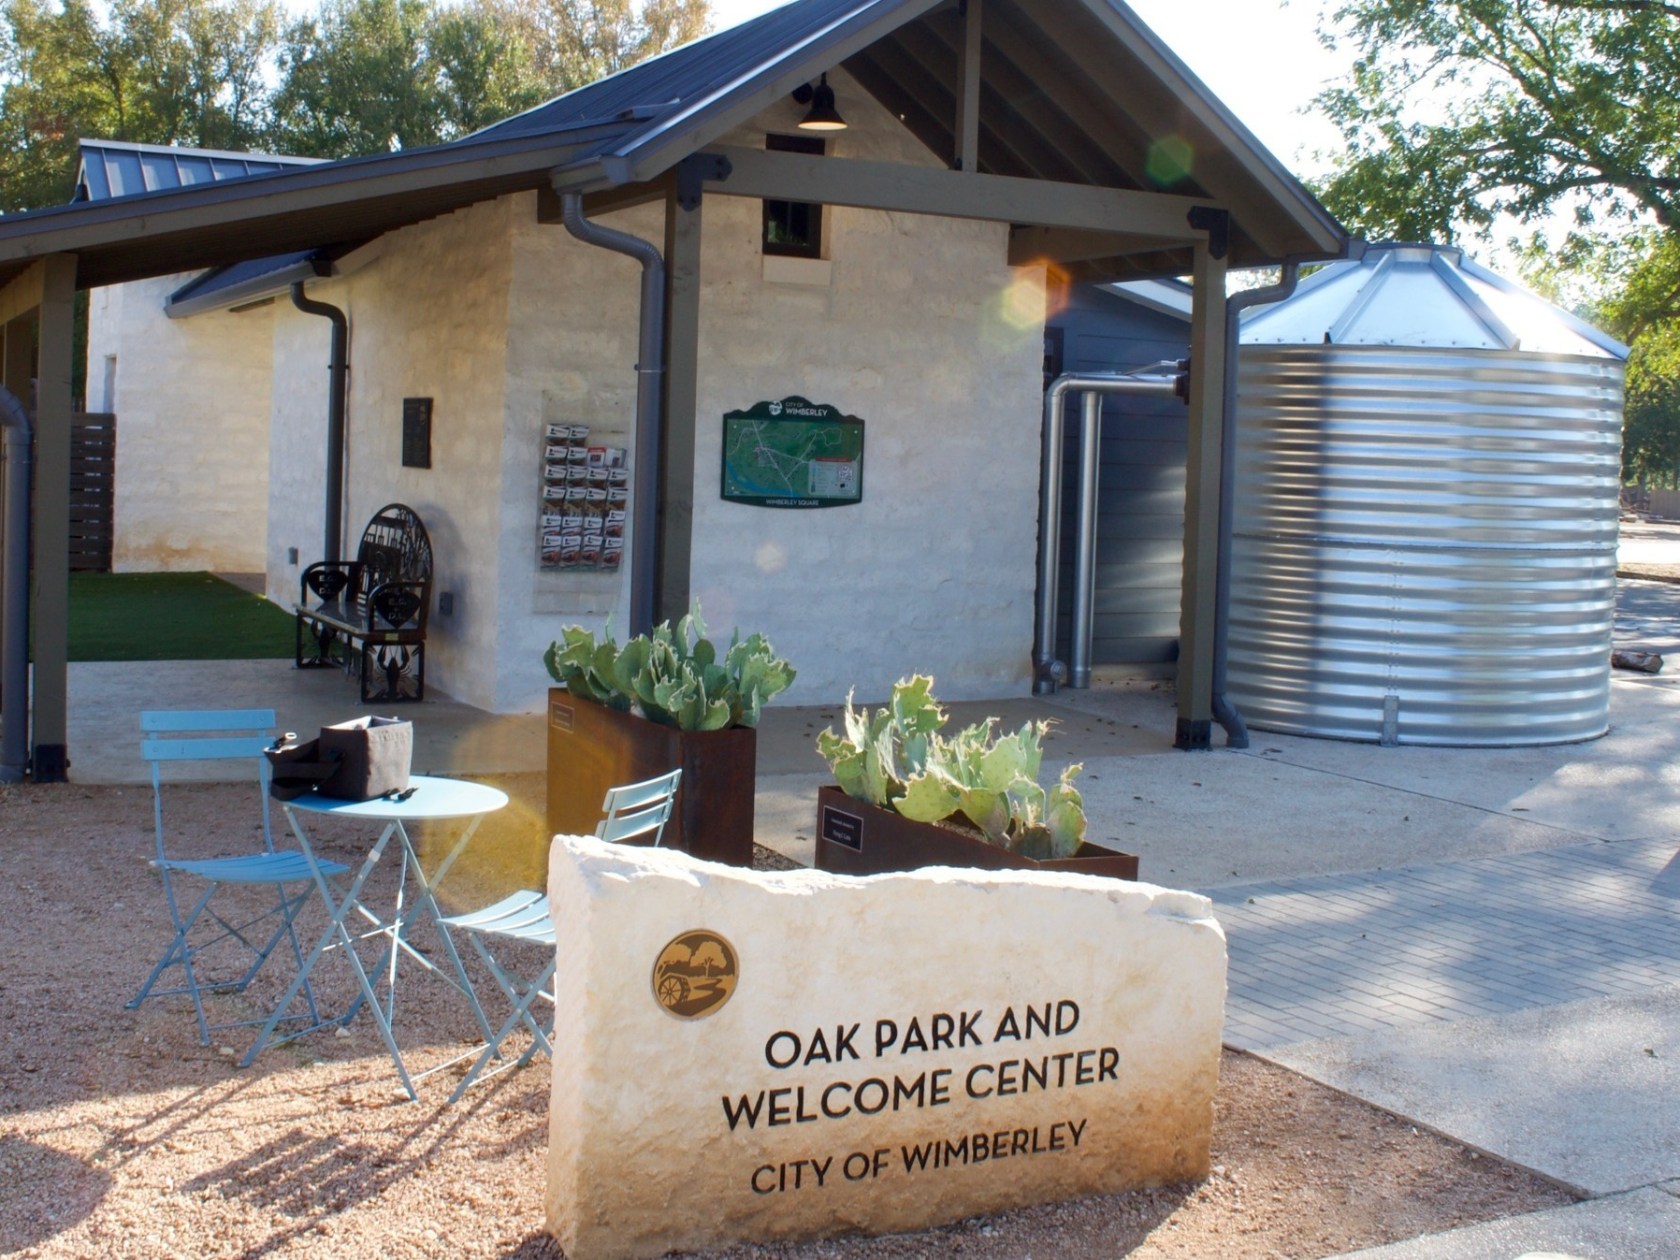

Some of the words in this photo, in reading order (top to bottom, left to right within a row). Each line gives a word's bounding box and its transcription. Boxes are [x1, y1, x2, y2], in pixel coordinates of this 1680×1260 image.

[786, 408, 828, 417] WIMBERLEY
[765, 1024, 860, 1068] OAK
[876, 1011, 982, 1057] PARK
[994, 1000, 1079, 1042] AND
[722, 1069, 952, 1131] WELCOME
[966, 1048, 1119, 1098] CENTER
[751, 1156, 833, 1194] CITY
[844, 1149, 890, 1182] OF
[901, 1118, 1087, 1173] WIMBERLEY
